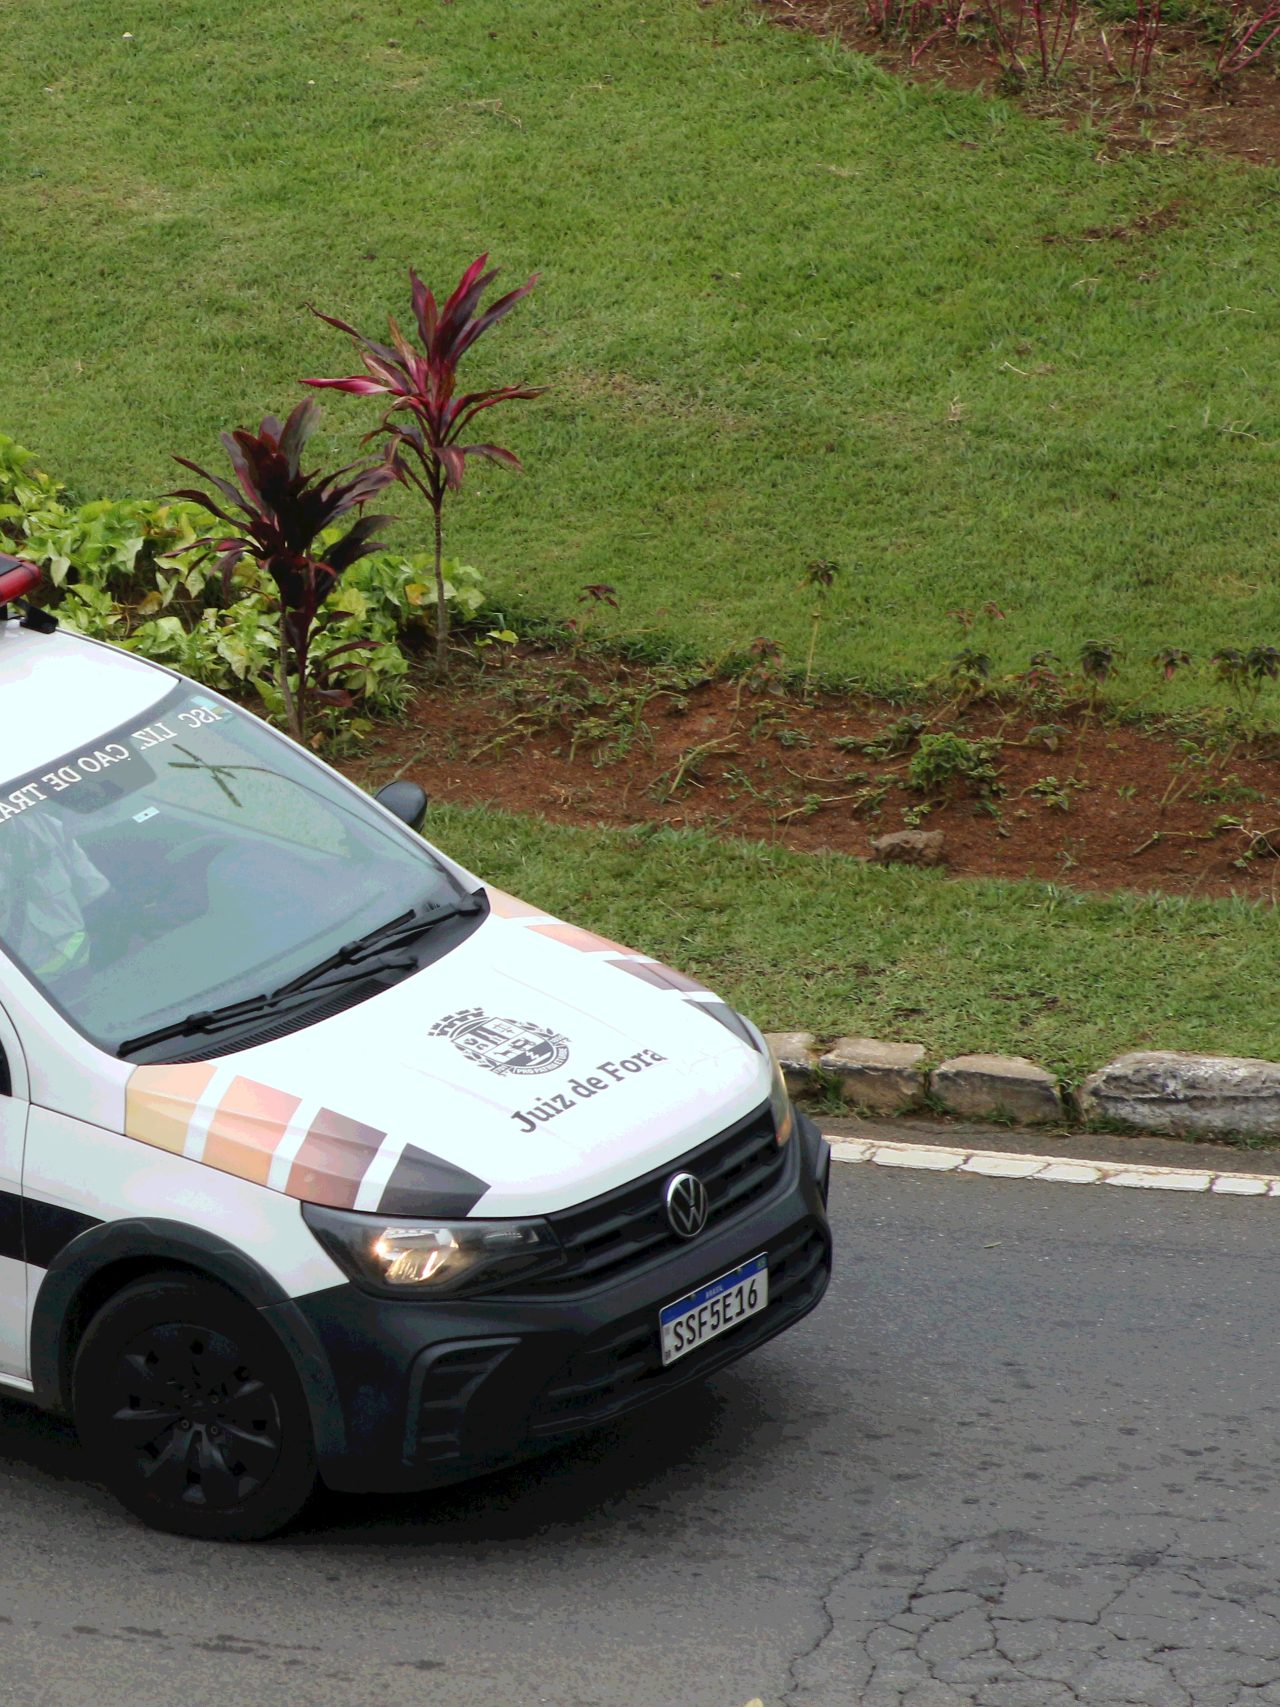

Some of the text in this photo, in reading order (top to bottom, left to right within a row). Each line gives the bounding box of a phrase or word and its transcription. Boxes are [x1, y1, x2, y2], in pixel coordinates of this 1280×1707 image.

[510, 1093, 577, 1133] Juiz
[568, 1076, 609, 1098] de
[596, 1048, 668, 1082] Fora
[673, 1279, 758, 1351] SSF5E16
[705, 1284, 724, 1299] BRASIL
